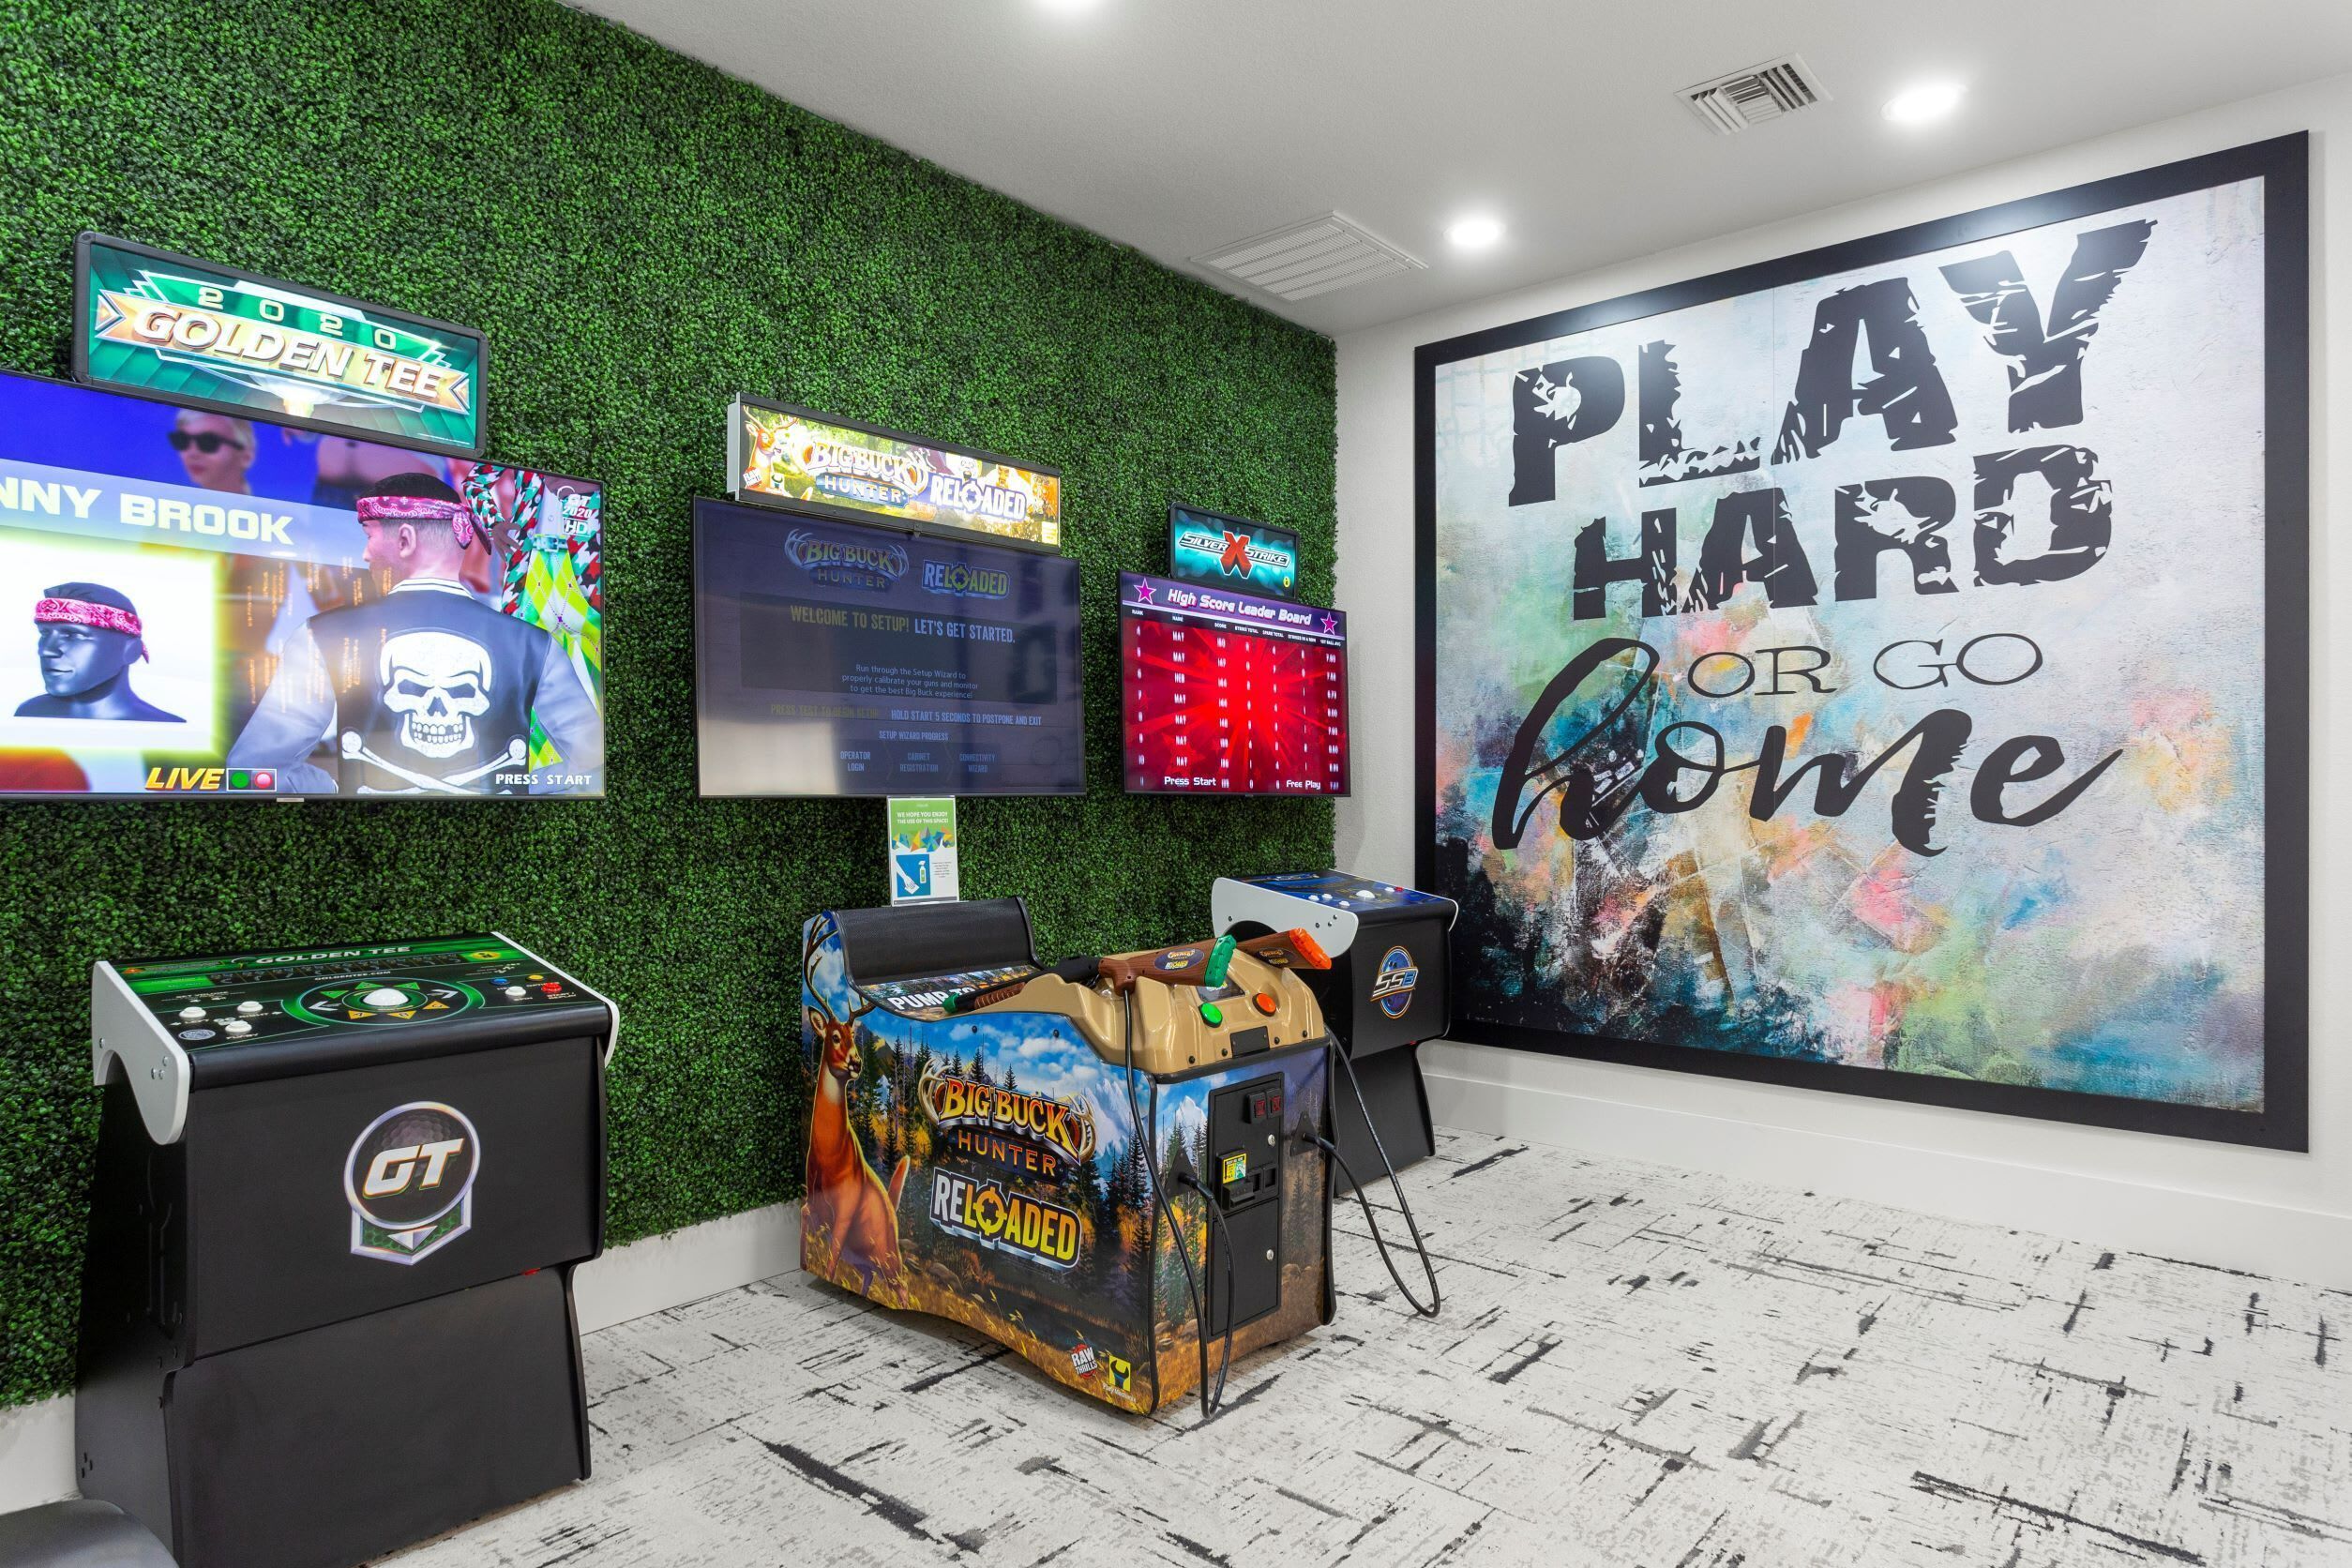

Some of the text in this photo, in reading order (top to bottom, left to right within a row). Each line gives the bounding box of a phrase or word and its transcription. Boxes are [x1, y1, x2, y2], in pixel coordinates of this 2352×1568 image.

[198, 286, 398, 350] 2020
[133, 305, 444, 400] GOLDEN TEE
[1509, 219, 2157, 507] PLAY
[808, 441, 925, 494] BIG BUCK
[824, 475, 903, 504] HUNTER
[928, 476, 1027, 518] RELOADED
[120, 493, 295, 545] BROOK
[563, 507, 593, 519] 2020
[564, 518, 590, 536] HD
[1573, 444, 2112, 620] HARD
[807, 539, 897, 577] BIG BUCK
[1184, 533, 1229, 551] SILVER
[1245, 546, 1289, 563] STRIKE
[817, 568, 886, 590] HUNTER
[924, 563, 1009, 596] RELOADED
[1168, 589, 1312, 626] High Score Leader Board
[790, 605, 1016, 644] WELCOME TO SETUP! LET'S GET STARTED.
[856, 664, 869, 672] Run
[871, 666, 898, 675] through
[900, 667, 912, 675] the
[913, 669, 932, 678] Setup
[934, 670, 957, 679] Wizard
[1688, 633, 2043, 699] OR GO
[841, 675, 872, 684] properly
[874, 676, 905, 686] calibrate
[907, 679, 922, 687] your
[924, 680, 939, 688] guns
[860, 686, 872, 694] get
[875, 686, 886, 694] the
[889, 686, 904, 695] best
[905, 687, 916, 697] Big
[917, 687, 933, 697] Buck
[935, 690, 972, 699] experience!
[891, 709, 1042, 726] HOLD START 5 SECONDS TO POSTPONE AND EXIT
[879, 731, 897, 740] SETUP
[921, 731, 949, 741] PROGRESS
[1492, 638, 2123, 858] home
[840, 751, 871, 761] OPERATOR
[847, 762, 865, 772] LOGIN
[145, 767, 225, 791] LIVE
[496, 774, 592, 785] PRESS START
[1164, 776, 1216, 786] Press Start
[1305, 780, 1320, 790] Play
[256, 946, 411, 964] GOLDEN TEE
[314, 971, 391, 981] GOLDENTEE.COM
[1375, 968, 1418, 990] SSB
[887, 991, 949, 1010] PUMP
[940, 1078, 1078, 1158] BIG BUCK
[957, 1130, 1057, 1177] HUNTER
[363, 1138, 465, 1199] GT
[934, 1173, 1077, 1261] RELOADED
[1071, 1347, 1095, 1366] RAW
[1076, 1360, 1098, 1375] THRILLS
